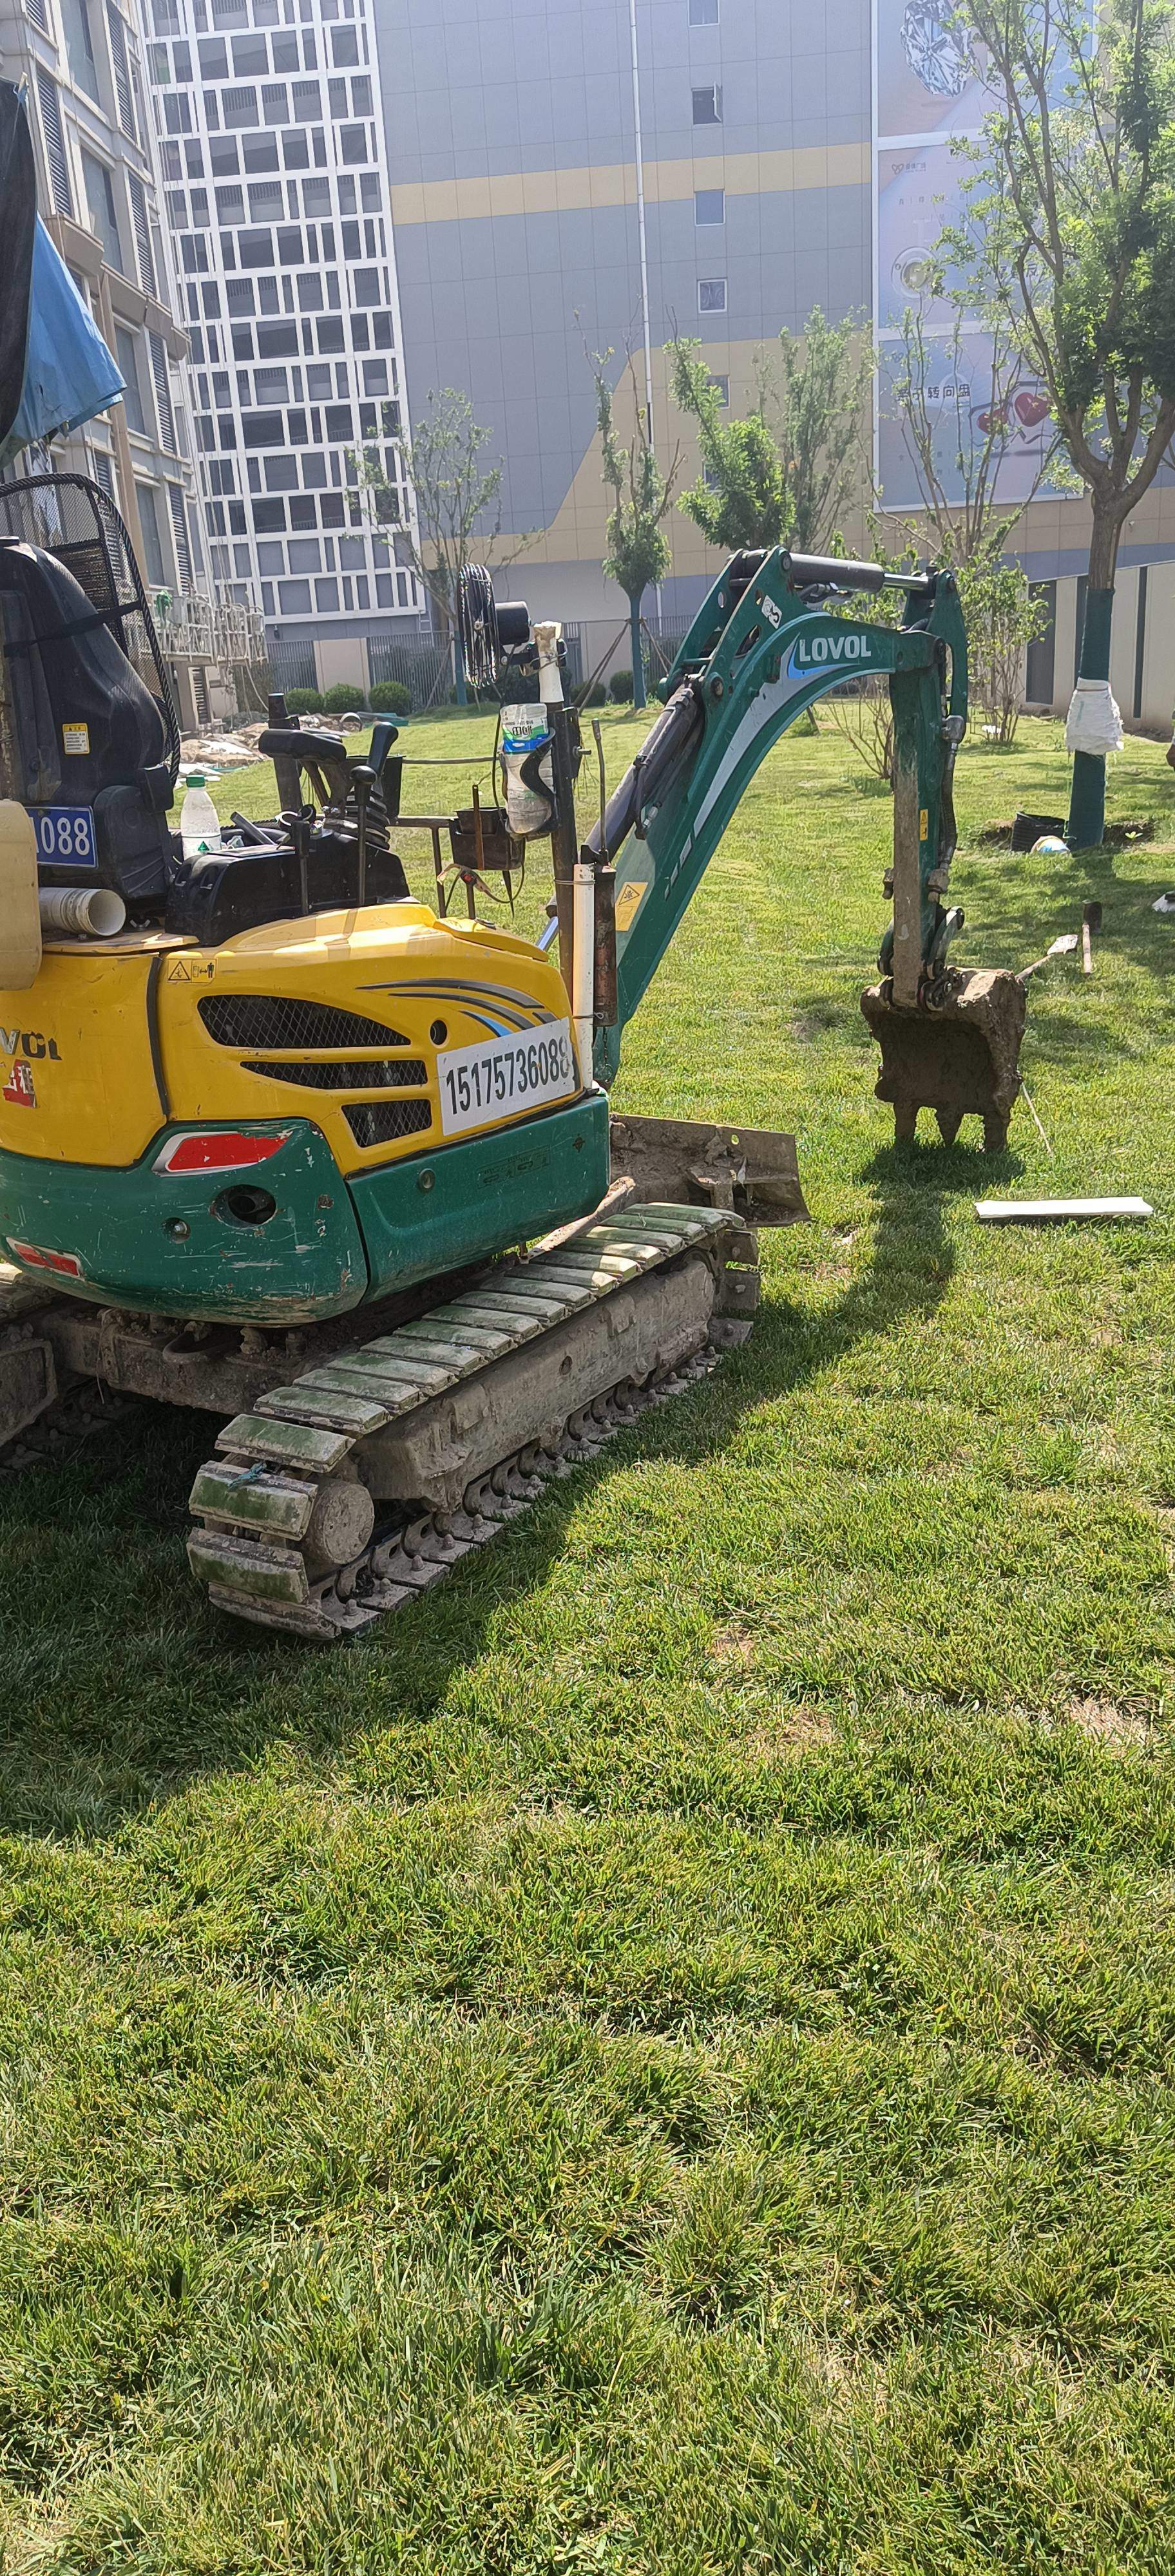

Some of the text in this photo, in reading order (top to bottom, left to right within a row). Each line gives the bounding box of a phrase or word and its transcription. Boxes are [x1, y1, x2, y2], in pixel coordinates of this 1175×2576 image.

[799, 635, 872, 662] LOVOL
[30, 817, 90, 856] 088
[446, 1036, 569, 1115] 15175736088
